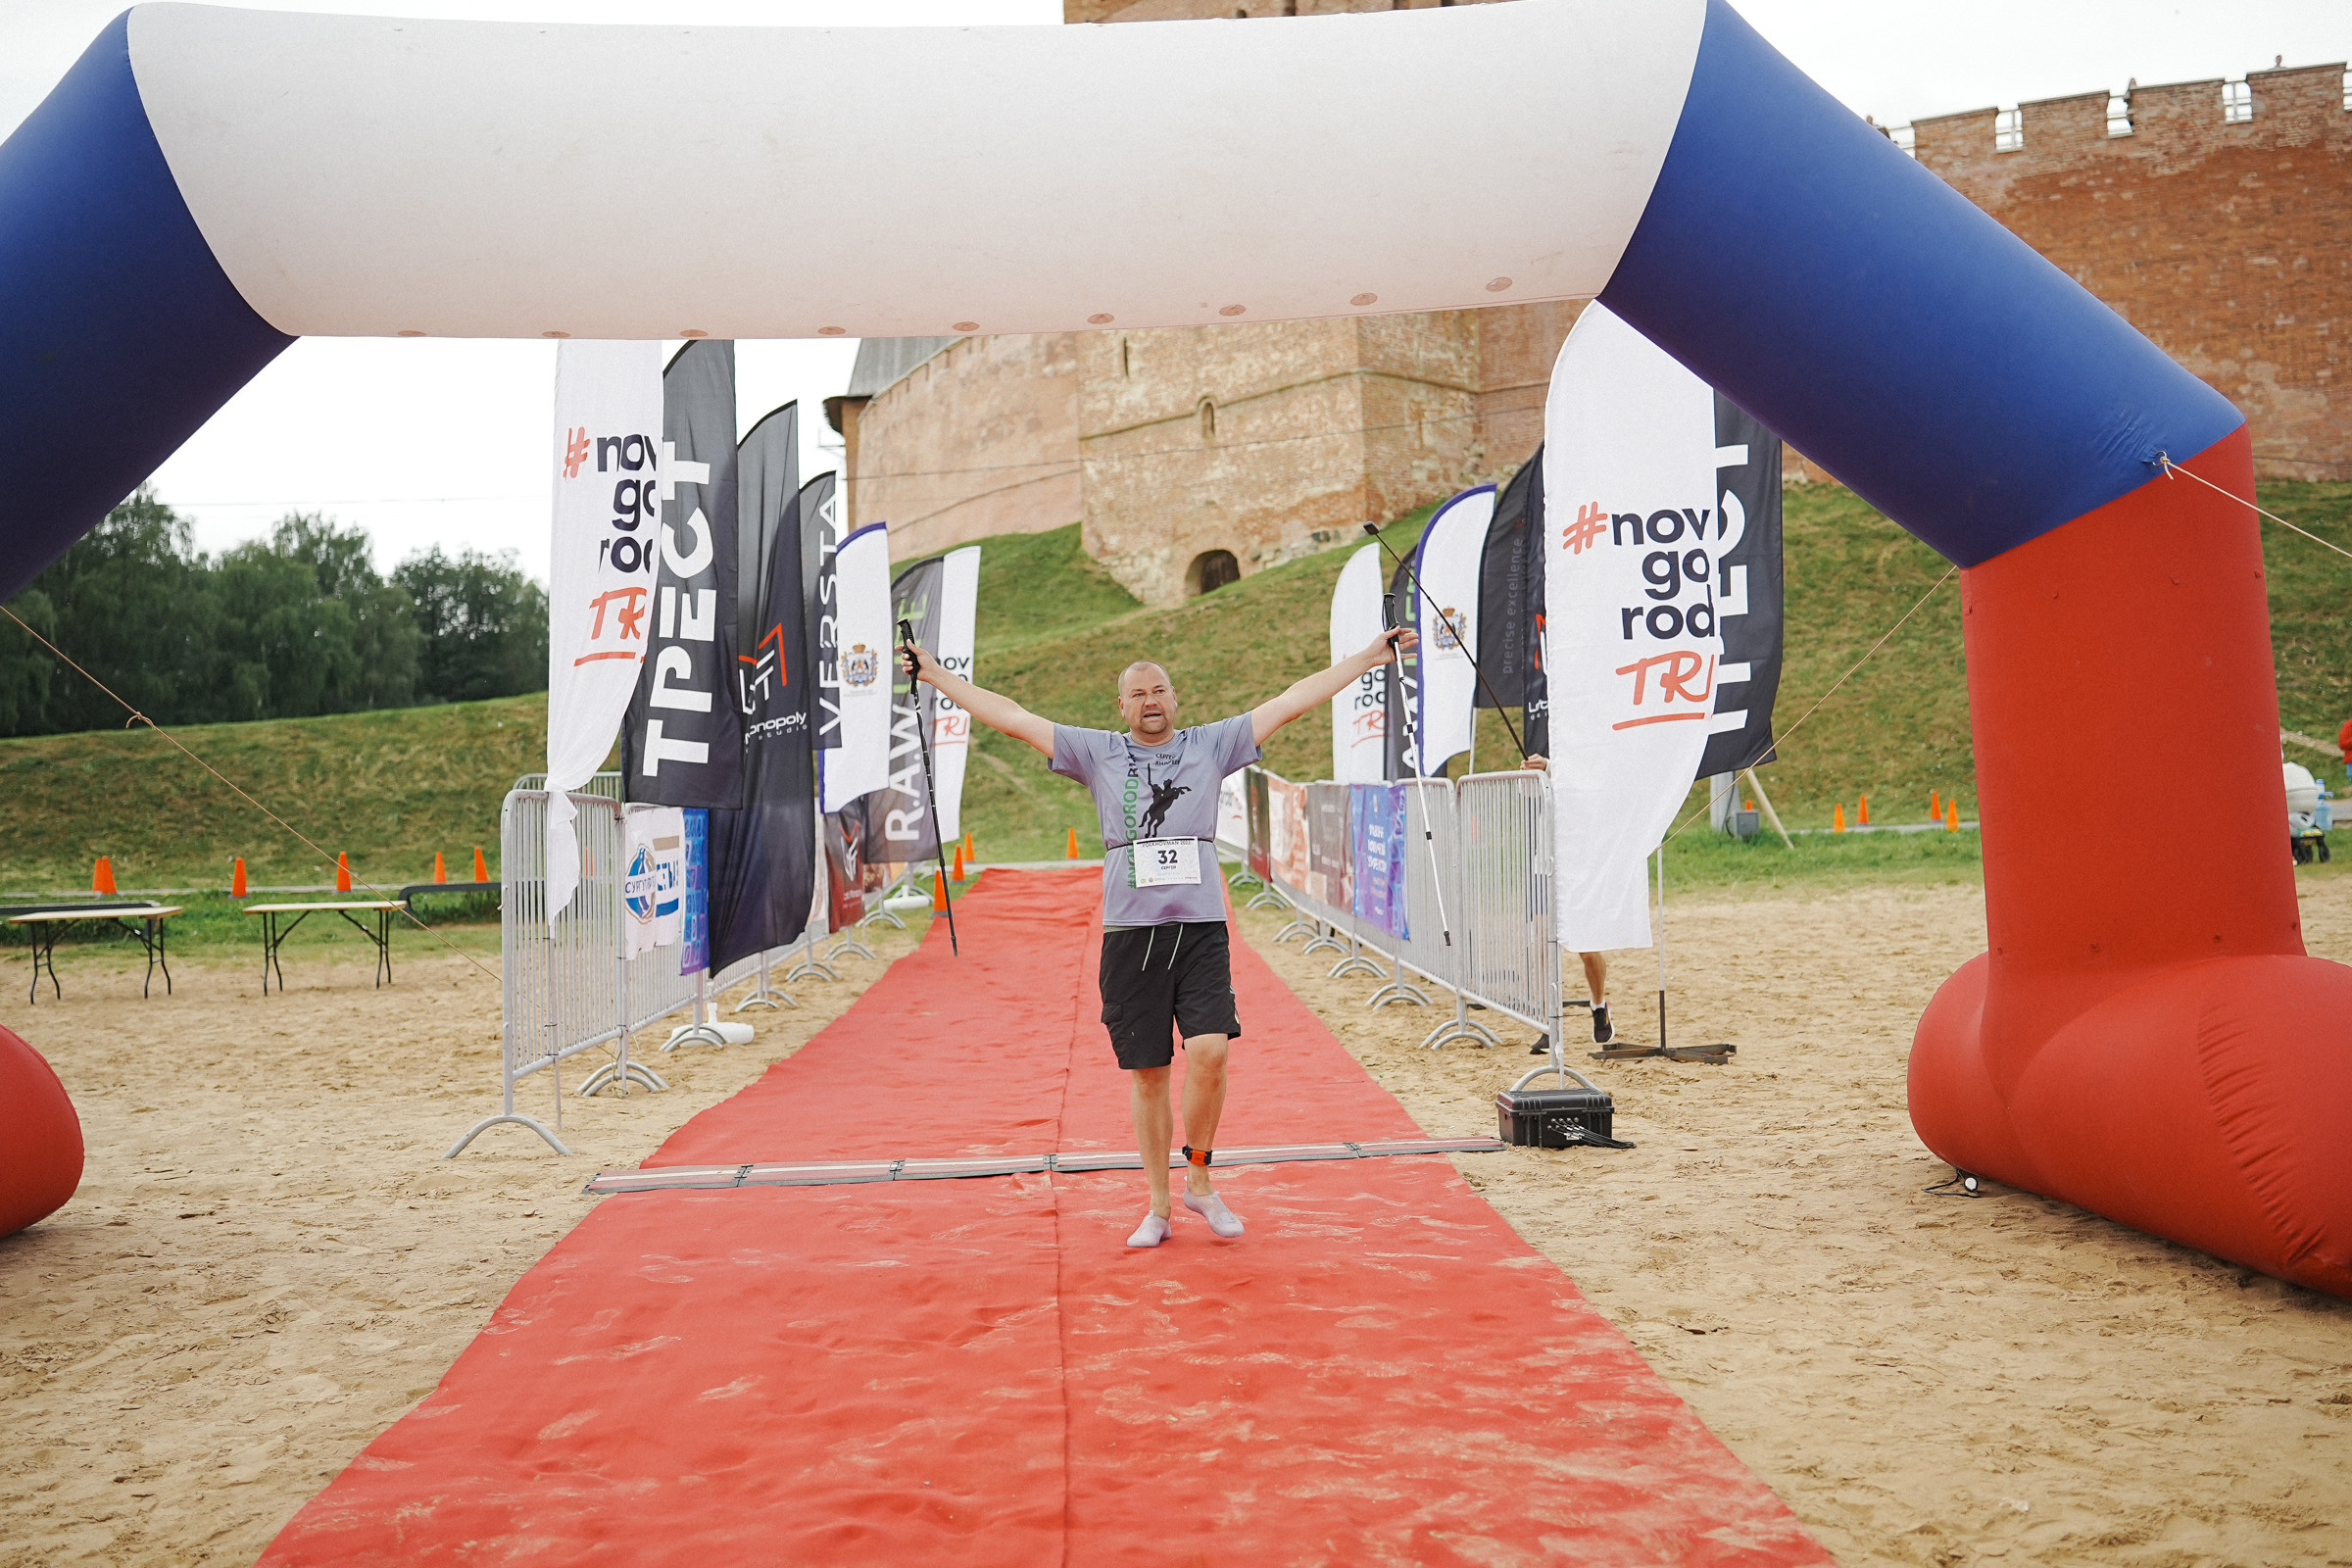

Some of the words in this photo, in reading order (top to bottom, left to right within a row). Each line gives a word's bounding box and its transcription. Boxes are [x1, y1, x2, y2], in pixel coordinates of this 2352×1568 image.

[1562, 501, 1711, 555] #nov
[1507, 538, 1523, 617] excellence
[1642, 548, 1709, 600] go
[589, 586, 653, 641] TR
[1622, 584, 1716, 640] rod
[1502, 621, 1515, 674] precise
[1157, 850, 1178, 864] 32
